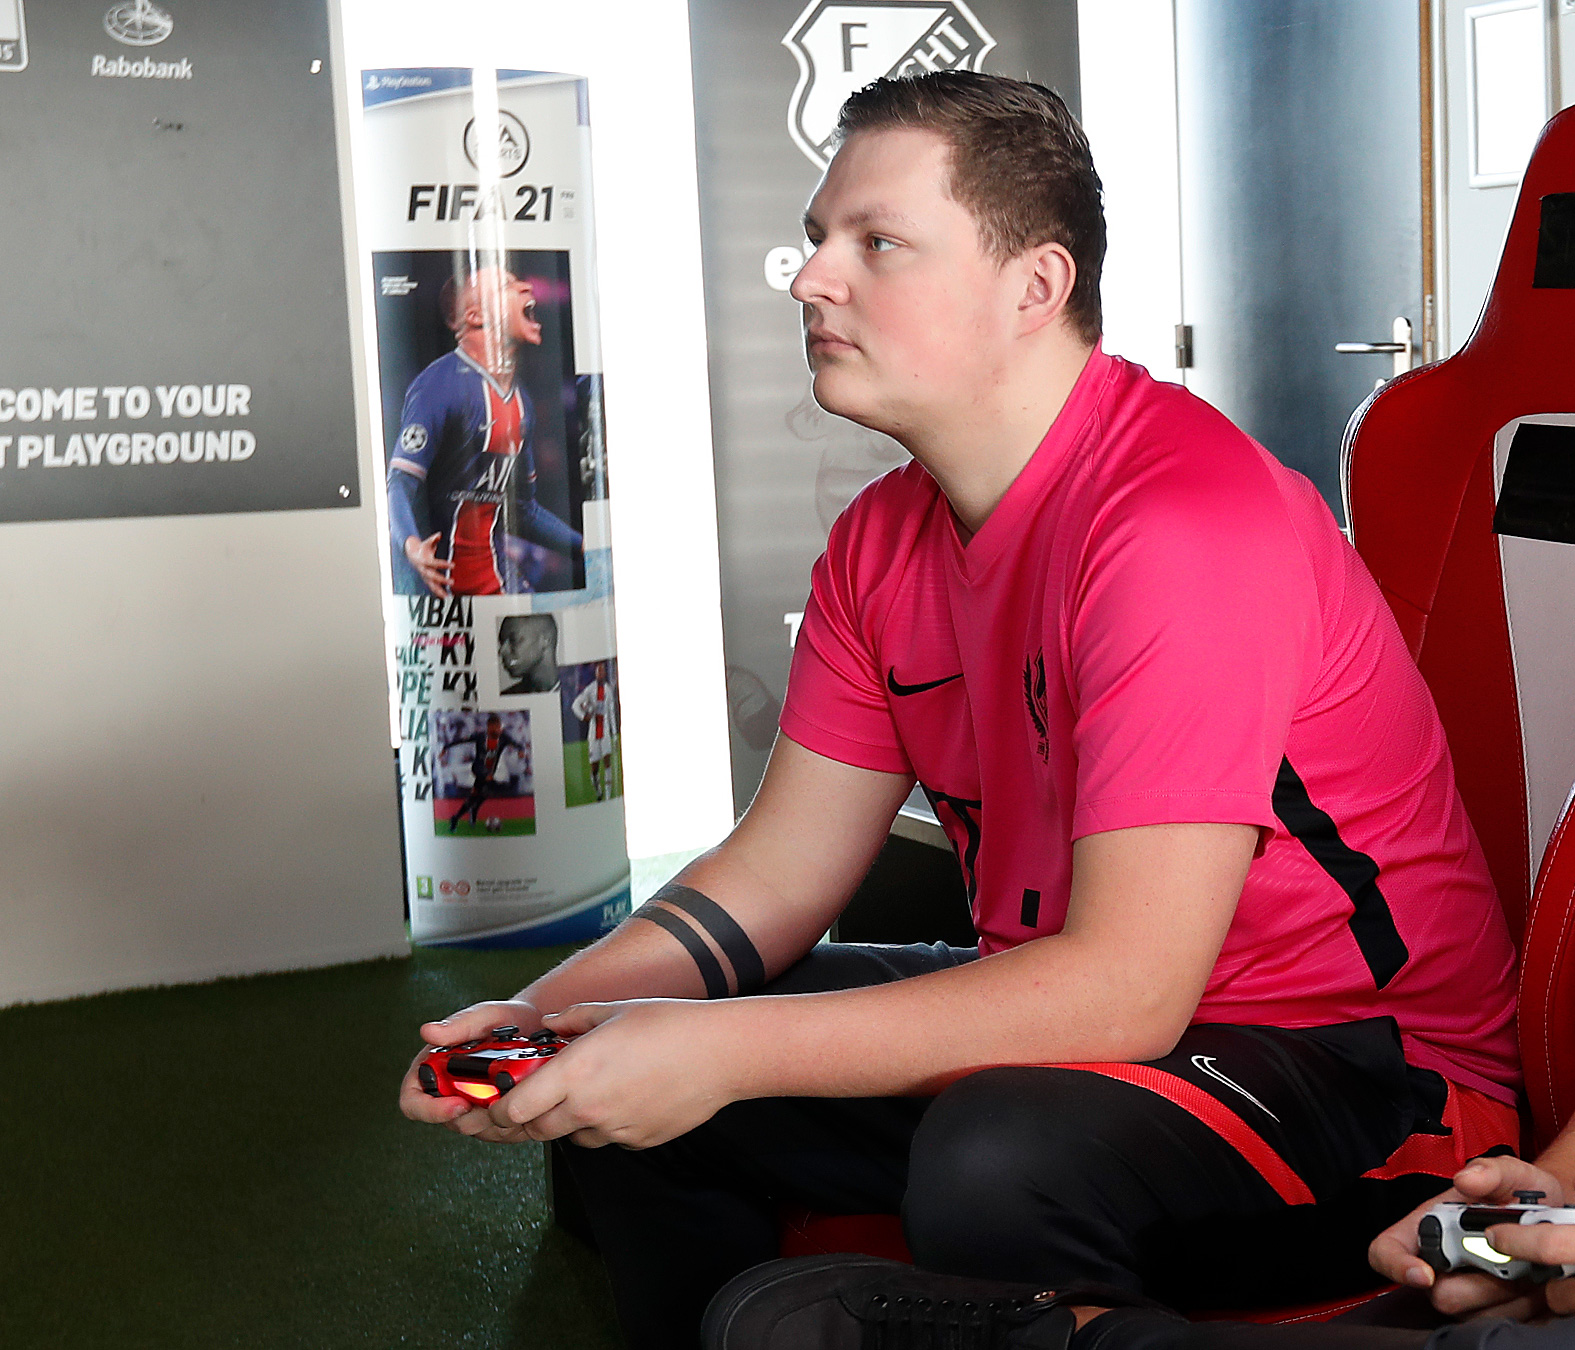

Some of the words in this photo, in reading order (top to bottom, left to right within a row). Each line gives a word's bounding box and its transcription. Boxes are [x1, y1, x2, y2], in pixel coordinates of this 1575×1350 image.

[841, 22, 868, 72] F
[91, 54, 193, 80] Rabobank
[513, 184, 554, 222] 21
[102, 385, 151, 420] TO
[155, 383, 251, 419] YOUR
[17, 429, 257, 469] PLAYGROUND
